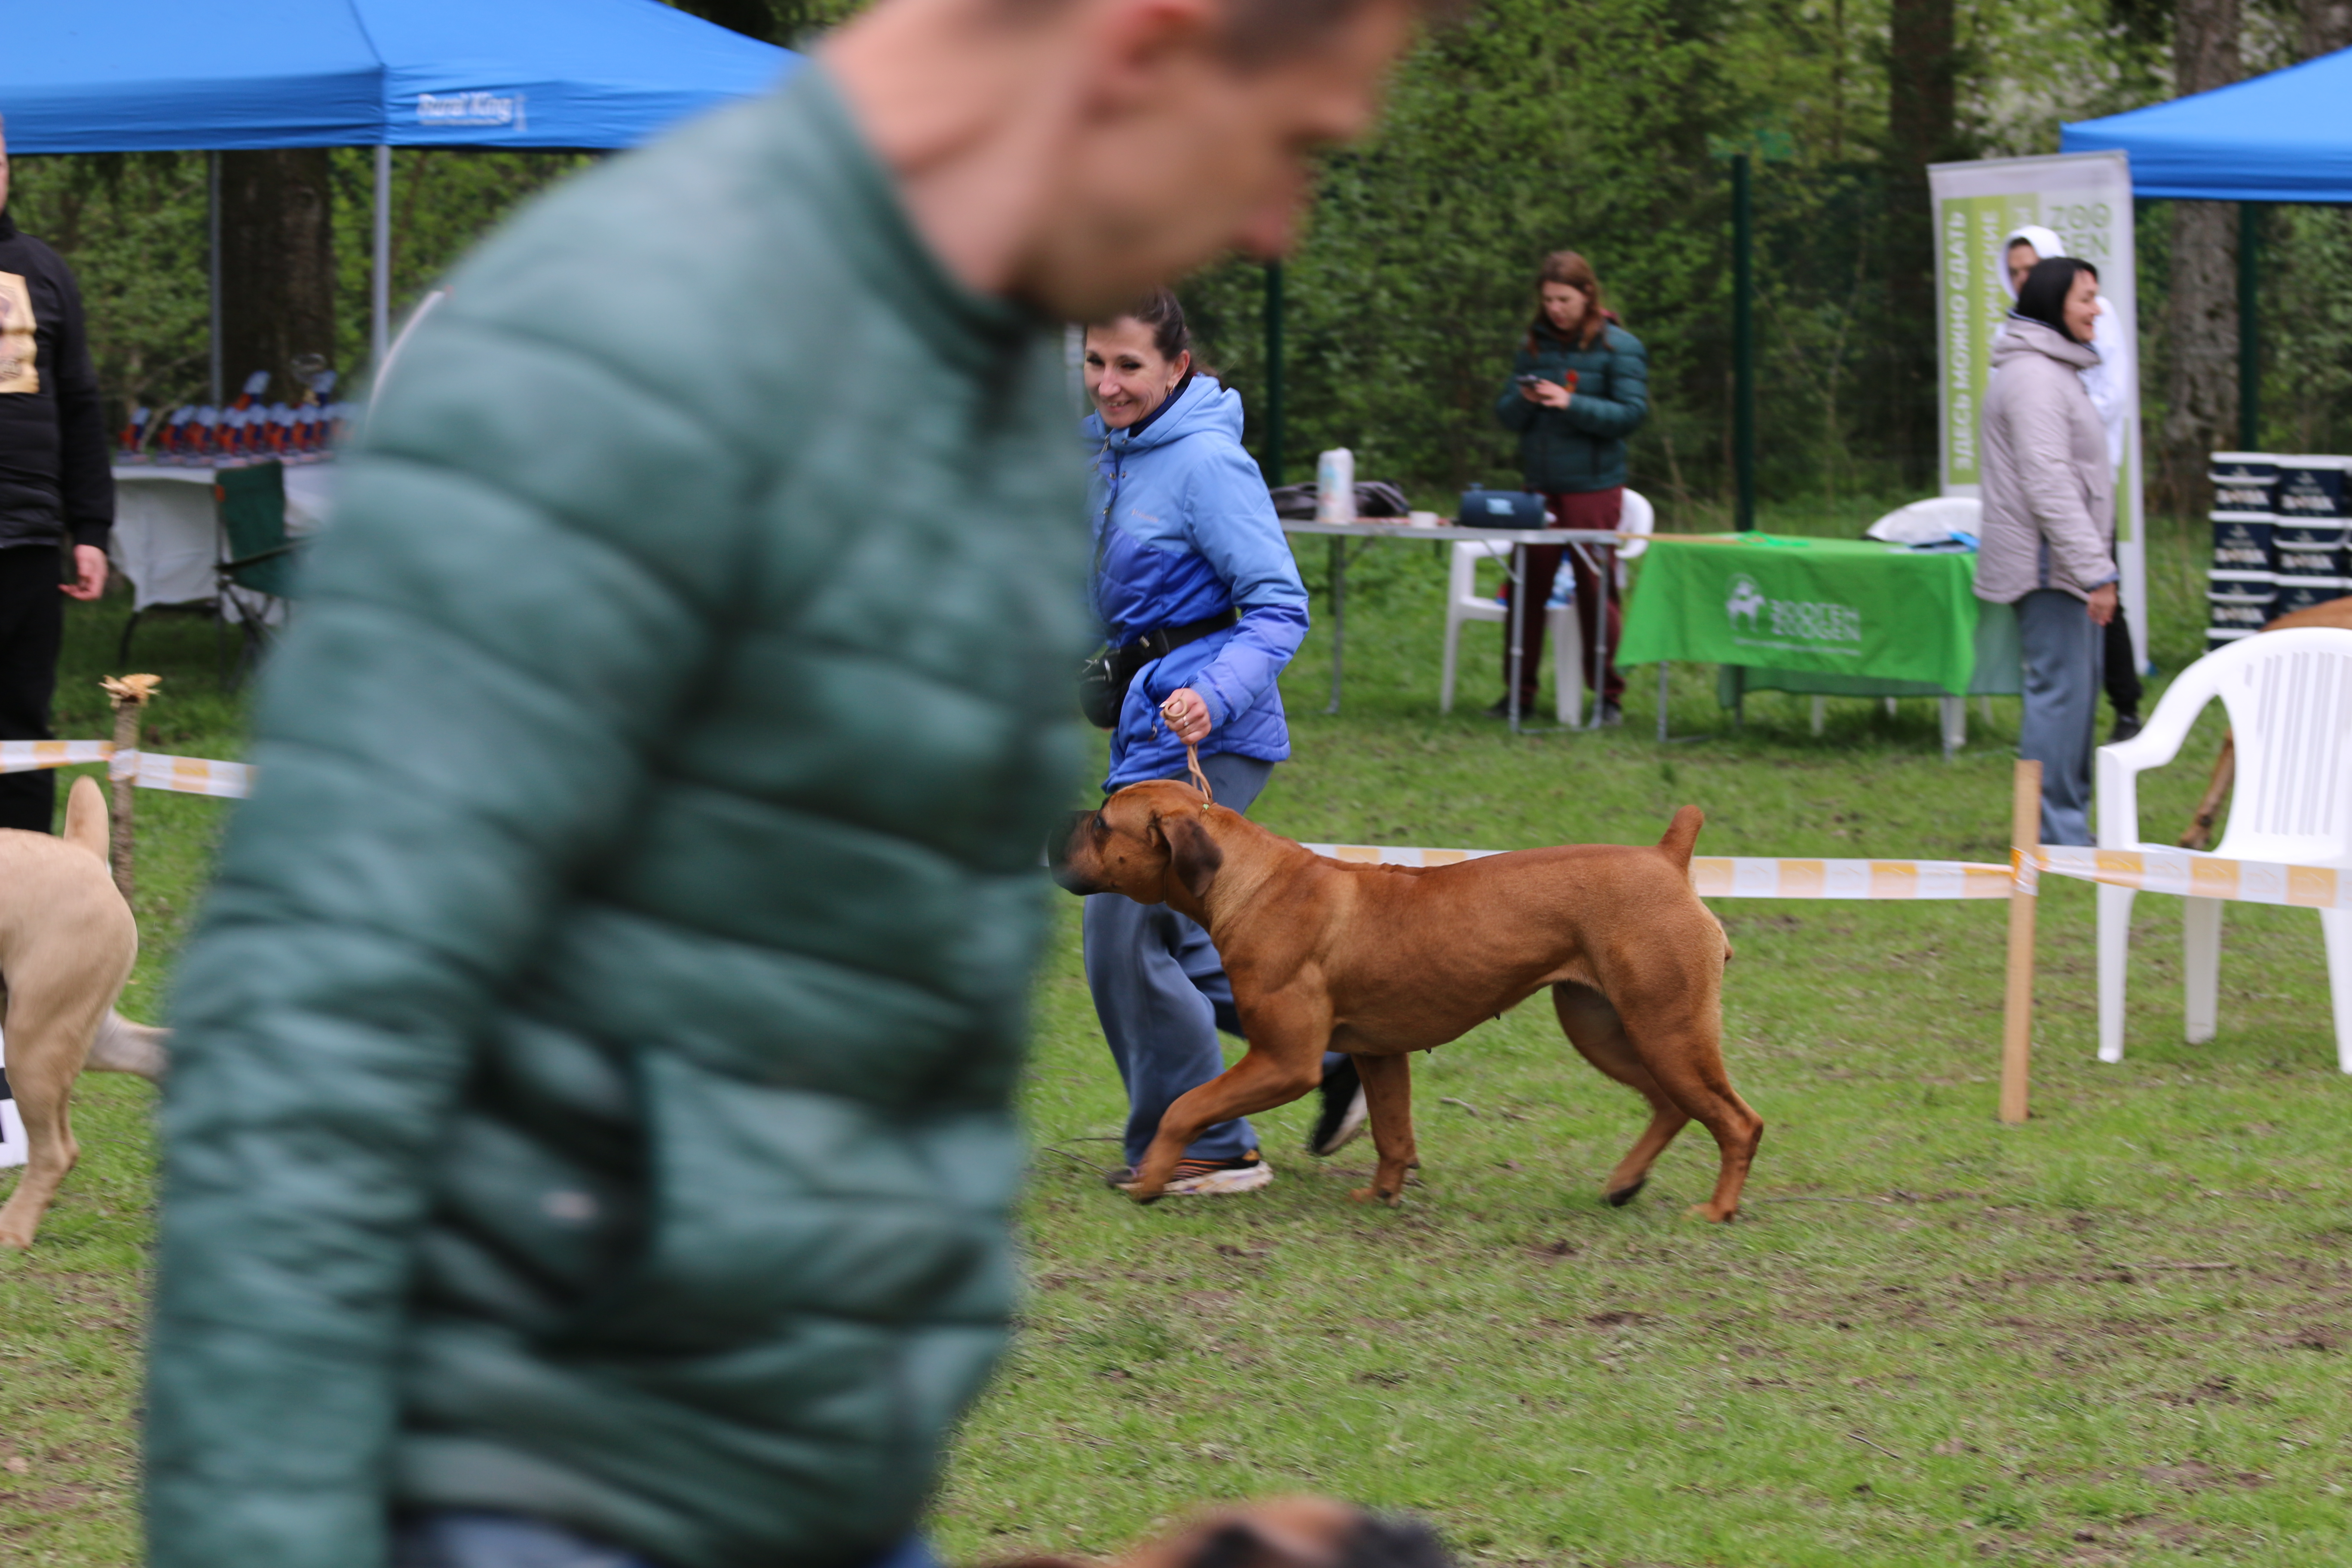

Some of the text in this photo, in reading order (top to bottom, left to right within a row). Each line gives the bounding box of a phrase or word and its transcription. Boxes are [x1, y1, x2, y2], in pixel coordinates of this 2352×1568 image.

[469, 91, 512, 122] King
[2049, 203, 2112, 230] ZOO
[1947, 211, 1975, 470] ЗДЕСЬ МОЖНО СДАТЬ
